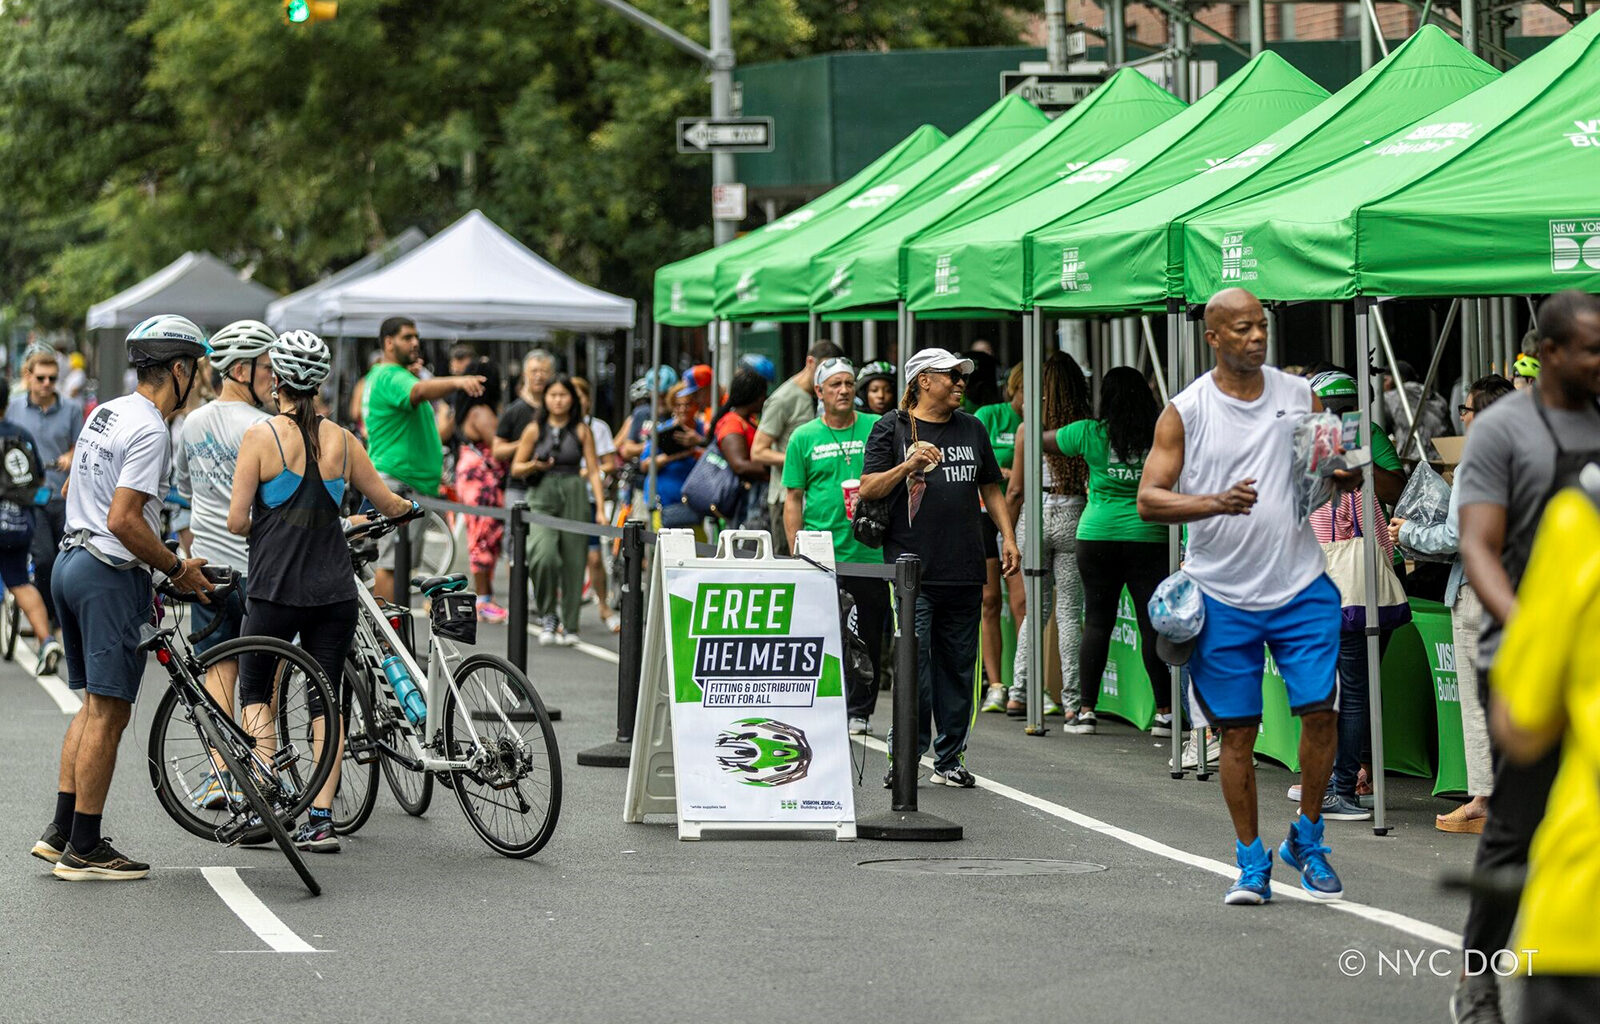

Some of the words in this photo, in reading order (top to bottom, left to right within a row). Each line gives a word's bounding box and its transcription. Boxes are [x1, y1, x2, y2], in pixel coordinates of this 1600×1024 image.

[1022, 86, 1055, 100] ONE
[1071, 85, 1099, 101] WA
[1552, 222, 1576, 234] NEW
[1581, 221, 1600, 233] YOR
[162, 331, 182, 340] VISION
[841, 440, 864, 449] ZERO
[947, 446, 975, 463] SAW
[942, 465, 977, 482] THAT!
[1107, 467, 1143, 481] STAF
[701, 588, 786, 630] FREE
[702, 642, 818, 672] HELMETS
[1435, 642, 1456, 670] VISI
[318, 671, 336, 703] KENDA
[710, 682, 743, 693] FITTING
[744, 683, 751, 693] &
[752, 682, 811, 693] DISTRIBUTION
[708, 694, 737, 704] EVENT
[737, 694, 755, 704] FOR
[755, 694, 772, 704] ALL
